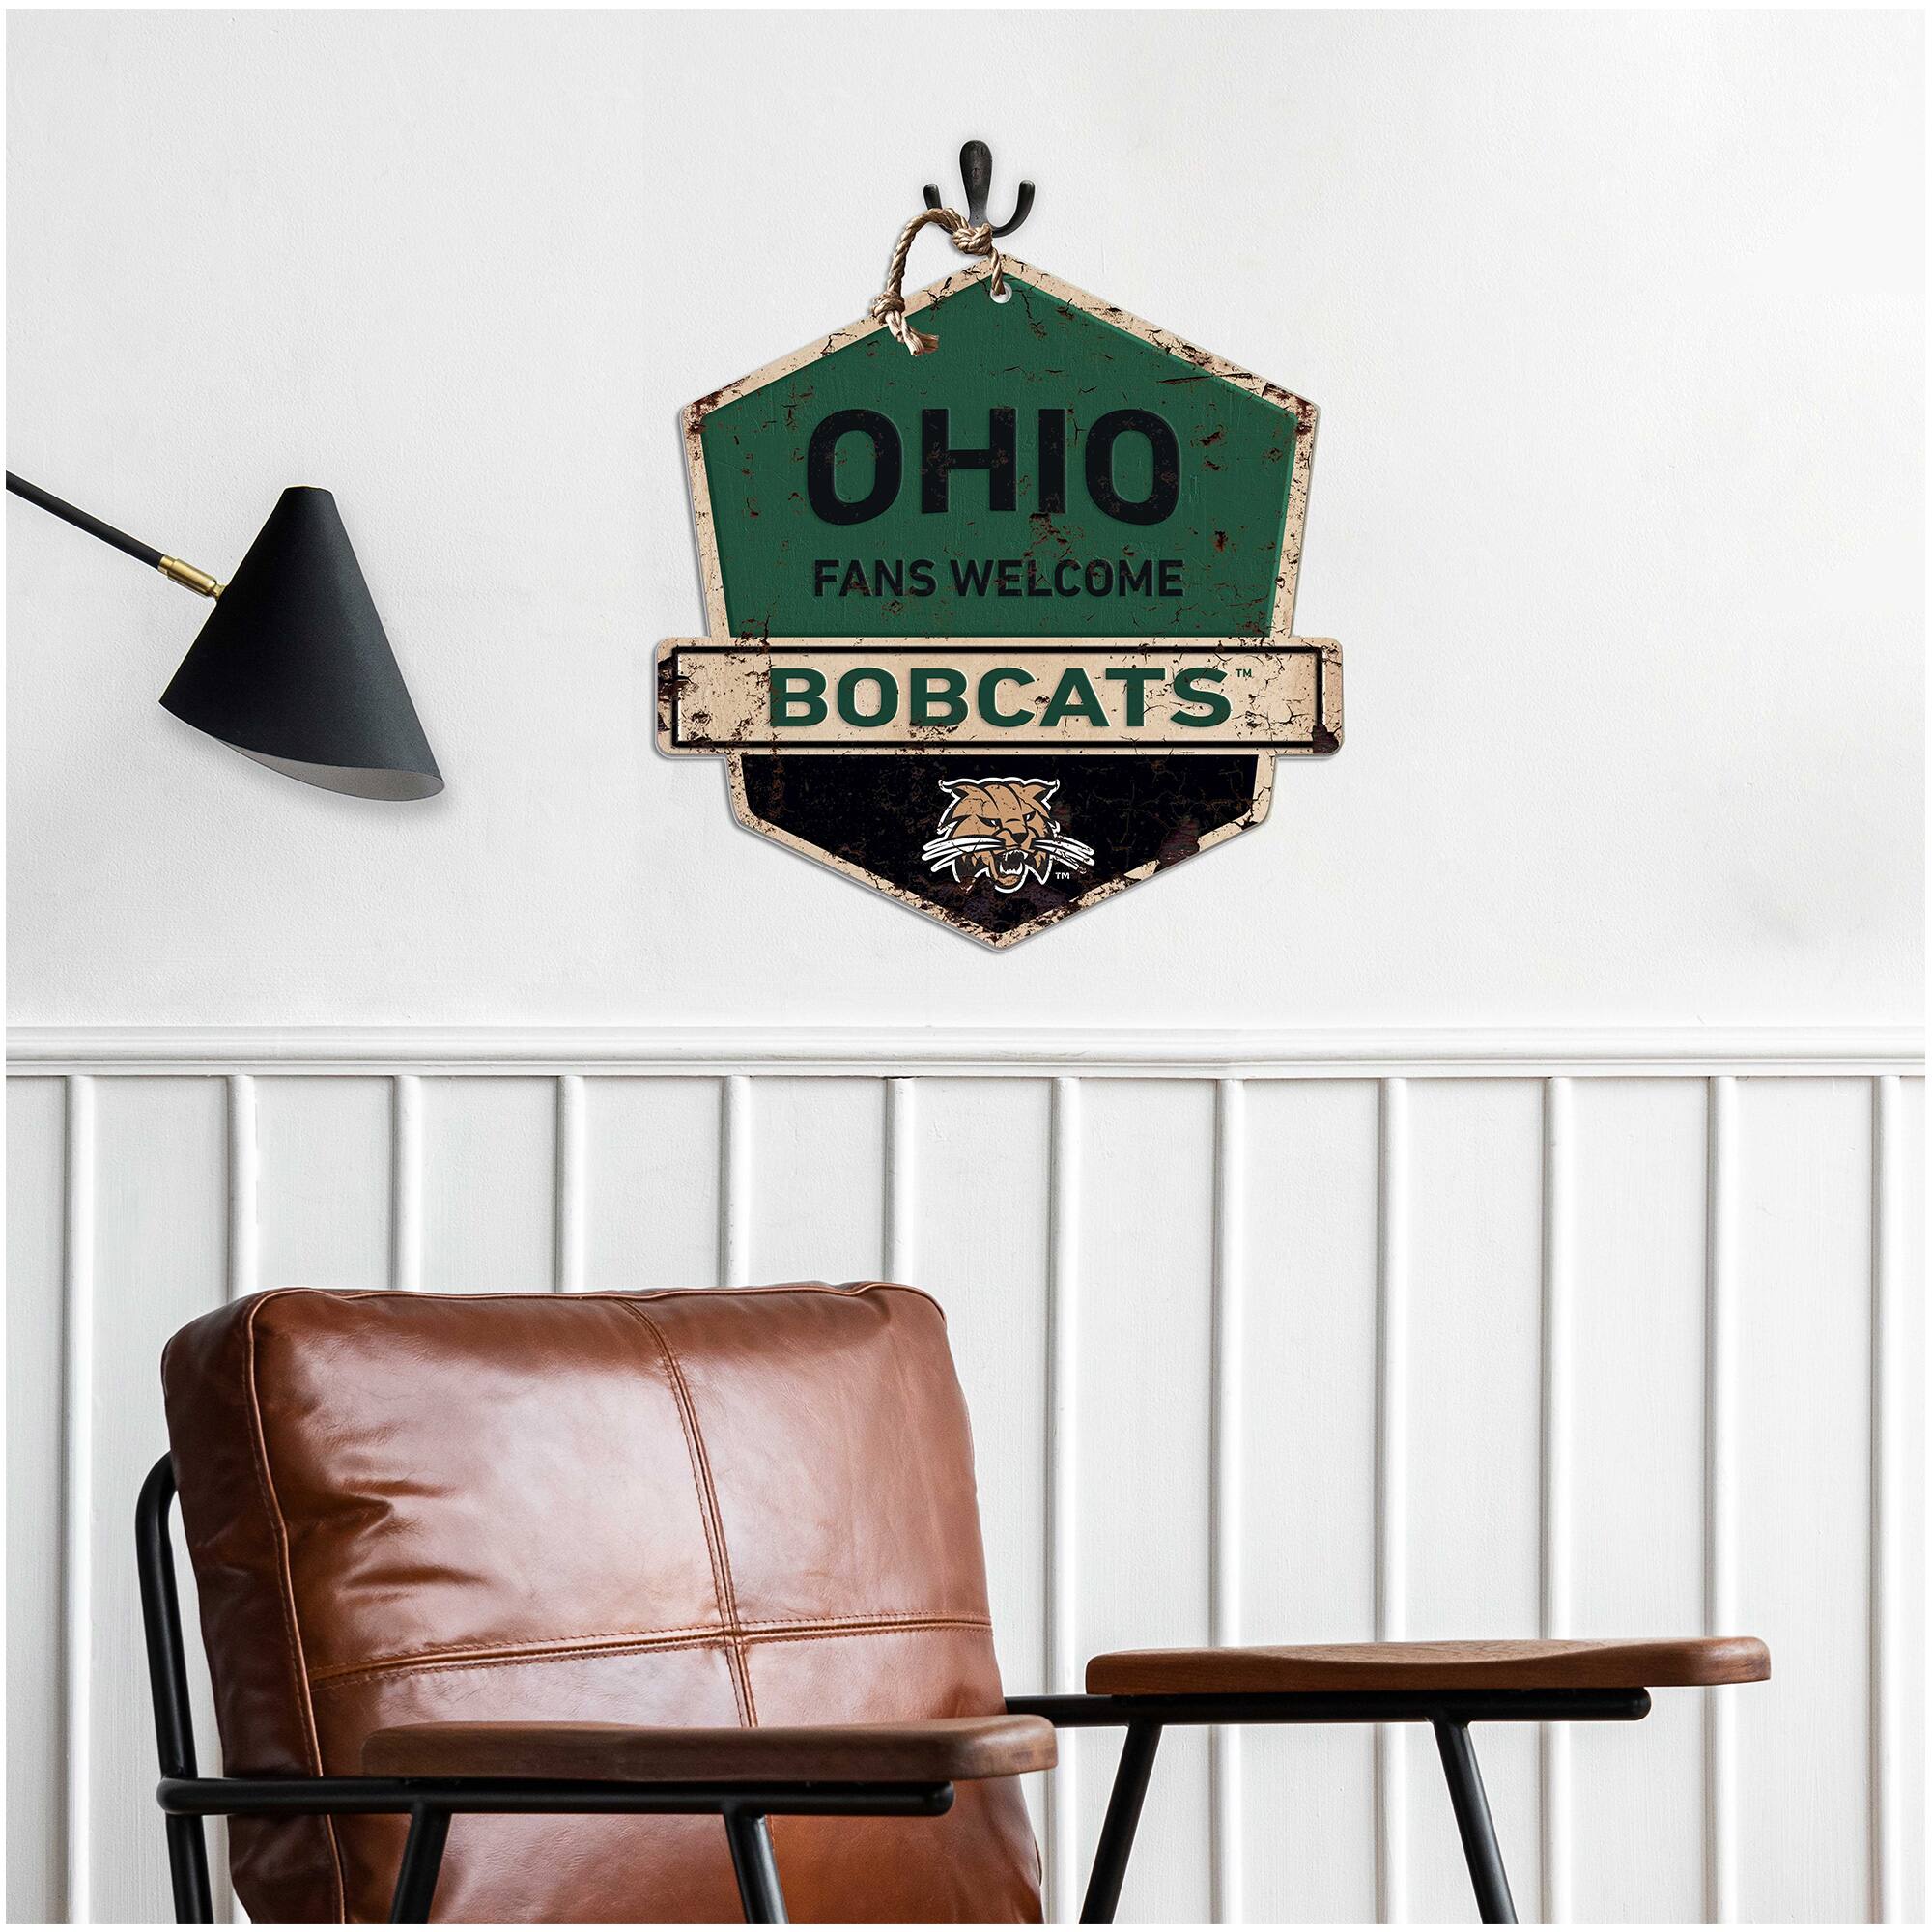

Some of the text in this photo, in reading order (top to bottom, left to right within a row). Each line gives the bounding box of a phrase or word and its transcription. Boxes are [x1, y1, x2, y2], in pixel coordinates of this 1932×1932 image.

[808, 408, 1180, 526] OHIO
[814, 559, 1184, 597] FANS WELCOME
[770, 668, 1232, 727] BOBCATS
